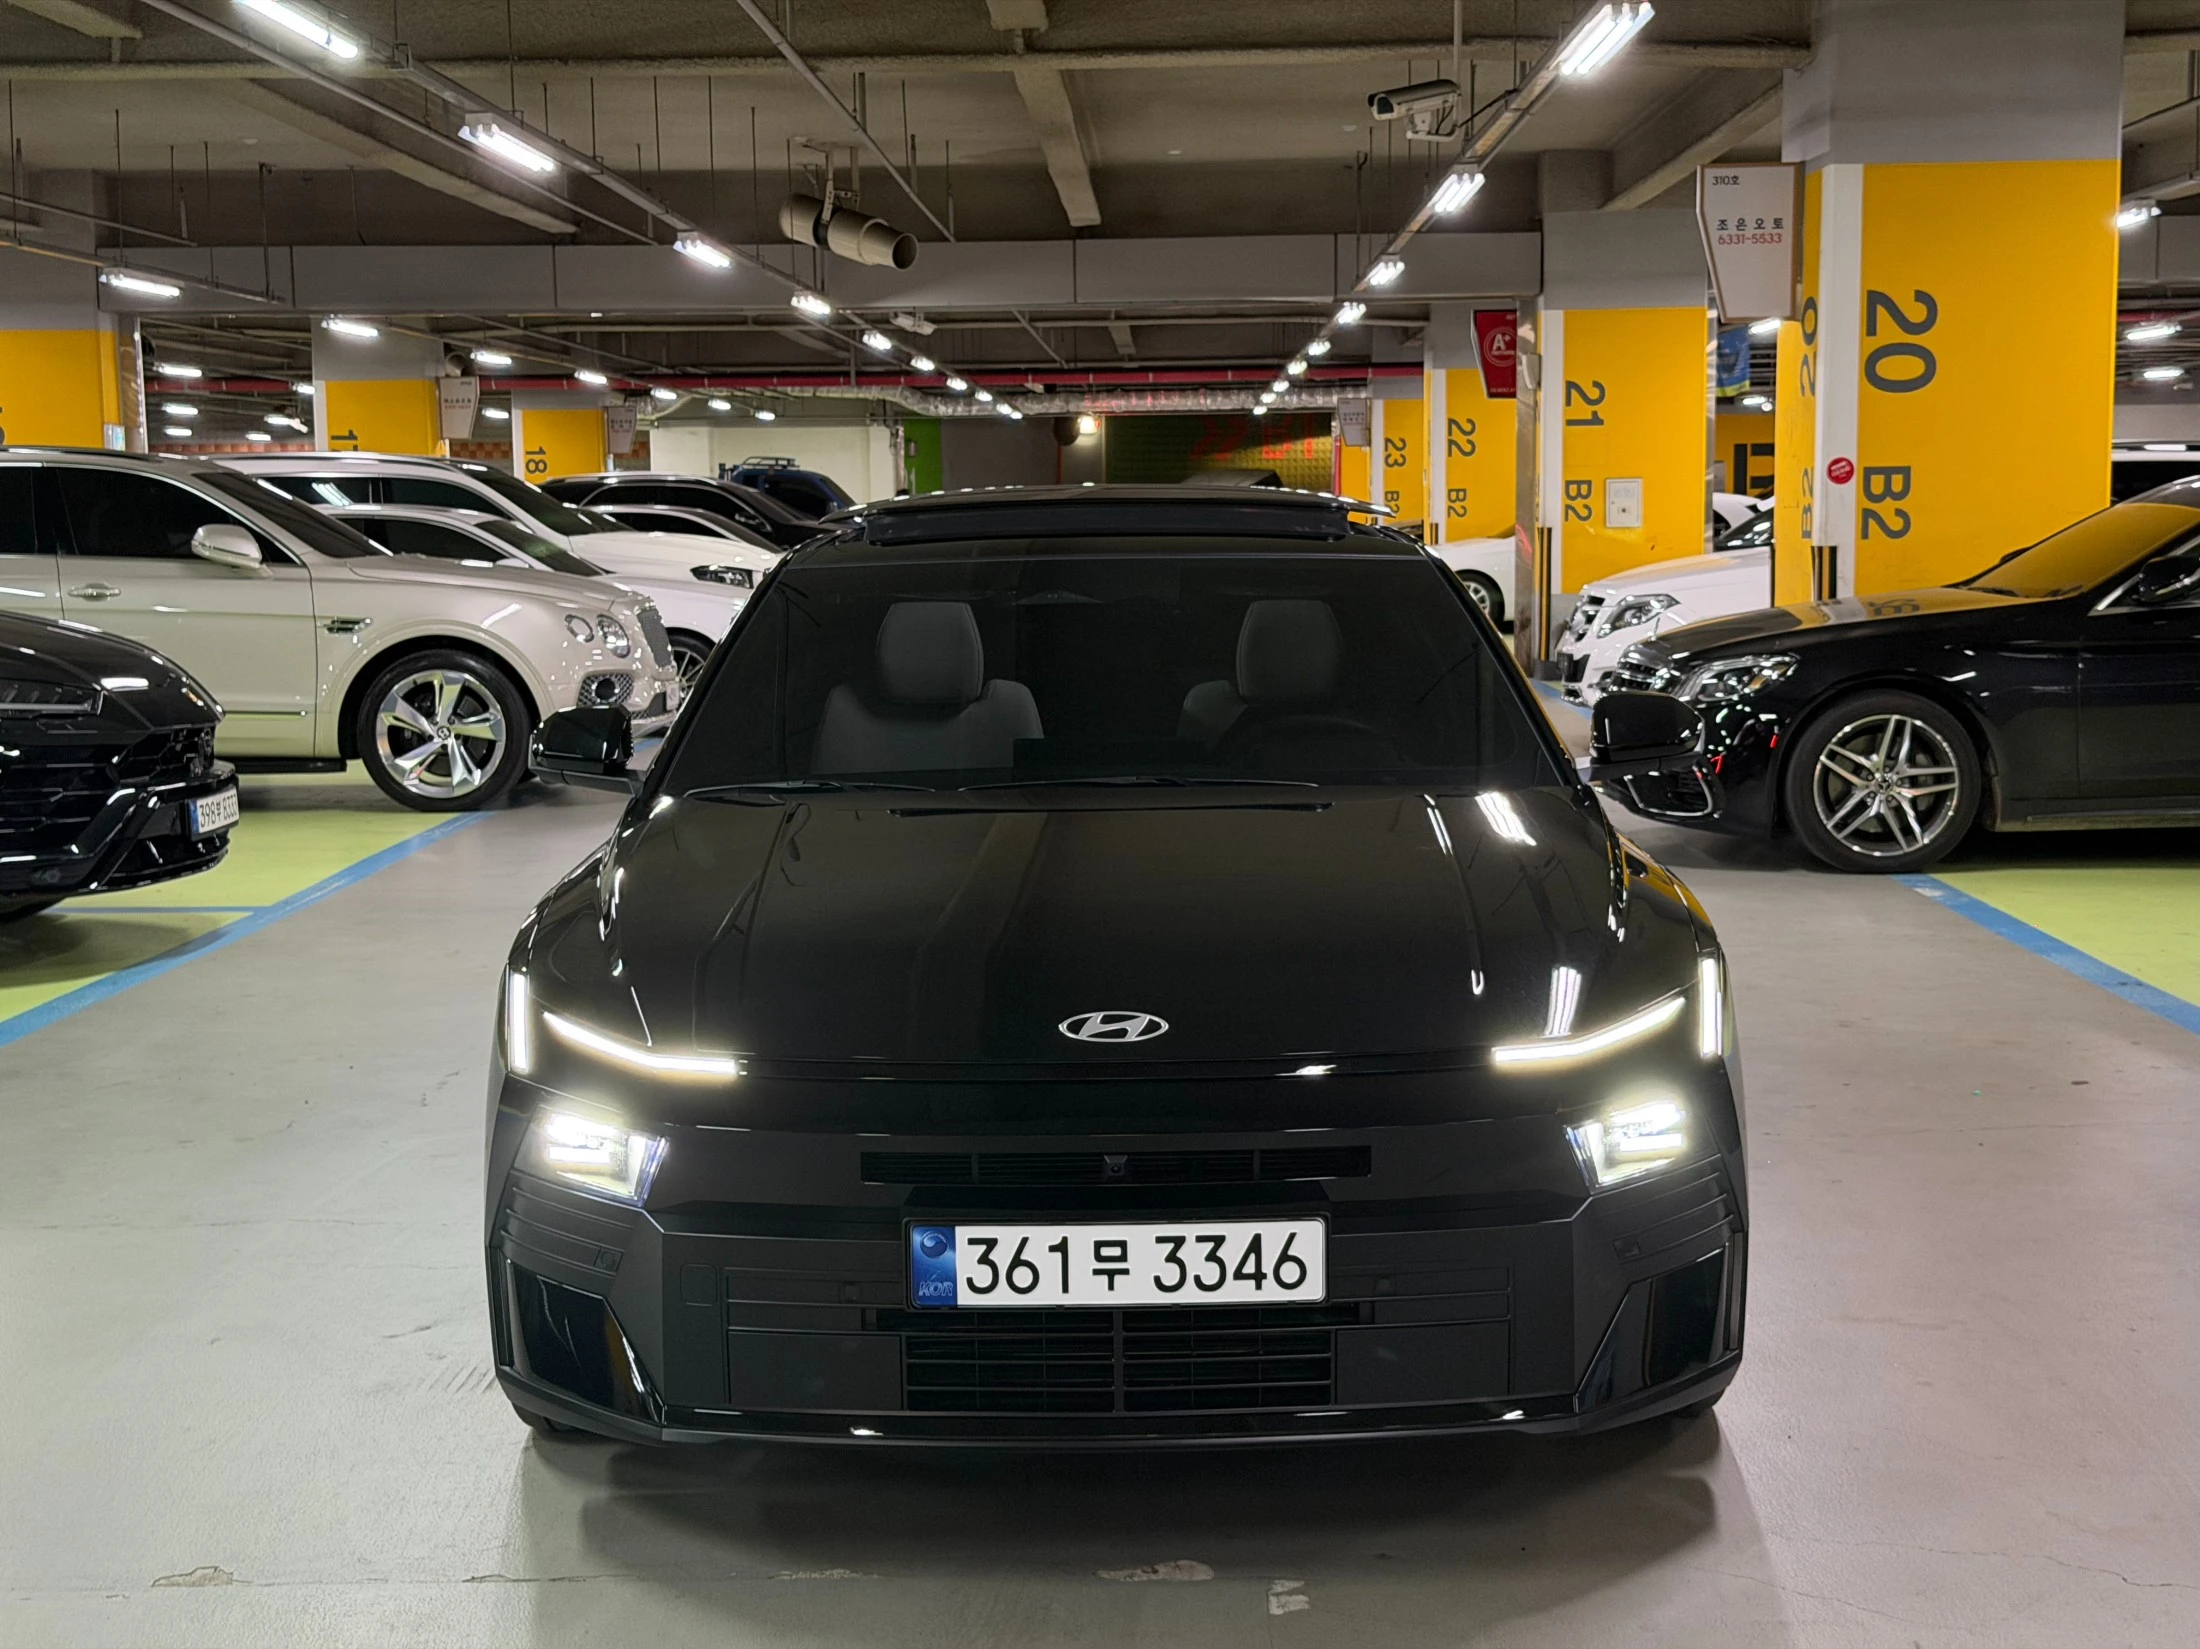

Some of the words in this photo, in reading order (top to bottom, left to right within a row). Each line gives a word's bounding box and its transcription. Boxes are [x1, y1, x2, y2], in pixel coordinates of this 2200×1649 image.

[1712, 175, 1740, 186] 310호
[1717, 233, 1783, 245] 6331-5533
[1800, 296, 1818, 397] 20
[1864, 289, 1938, 394] 20
[1565, 380, 1606, 426] 21
[331, 429, 358, 452] 1
[1384, 437, 1407, 468] 23
[1447, 418, 1477, 458] 22
[525, 446, 548, 475] 18
[1447, 488, 1467, 518] B2
[1564, 480, 1593, 522] B2
[1861, 465, 1912, 540] B2
[965, 1235, 1131, 1295] 361무
[1152, 1231, 1308, 1293] 3346
[918, 1281, 954, 1297] KOR
